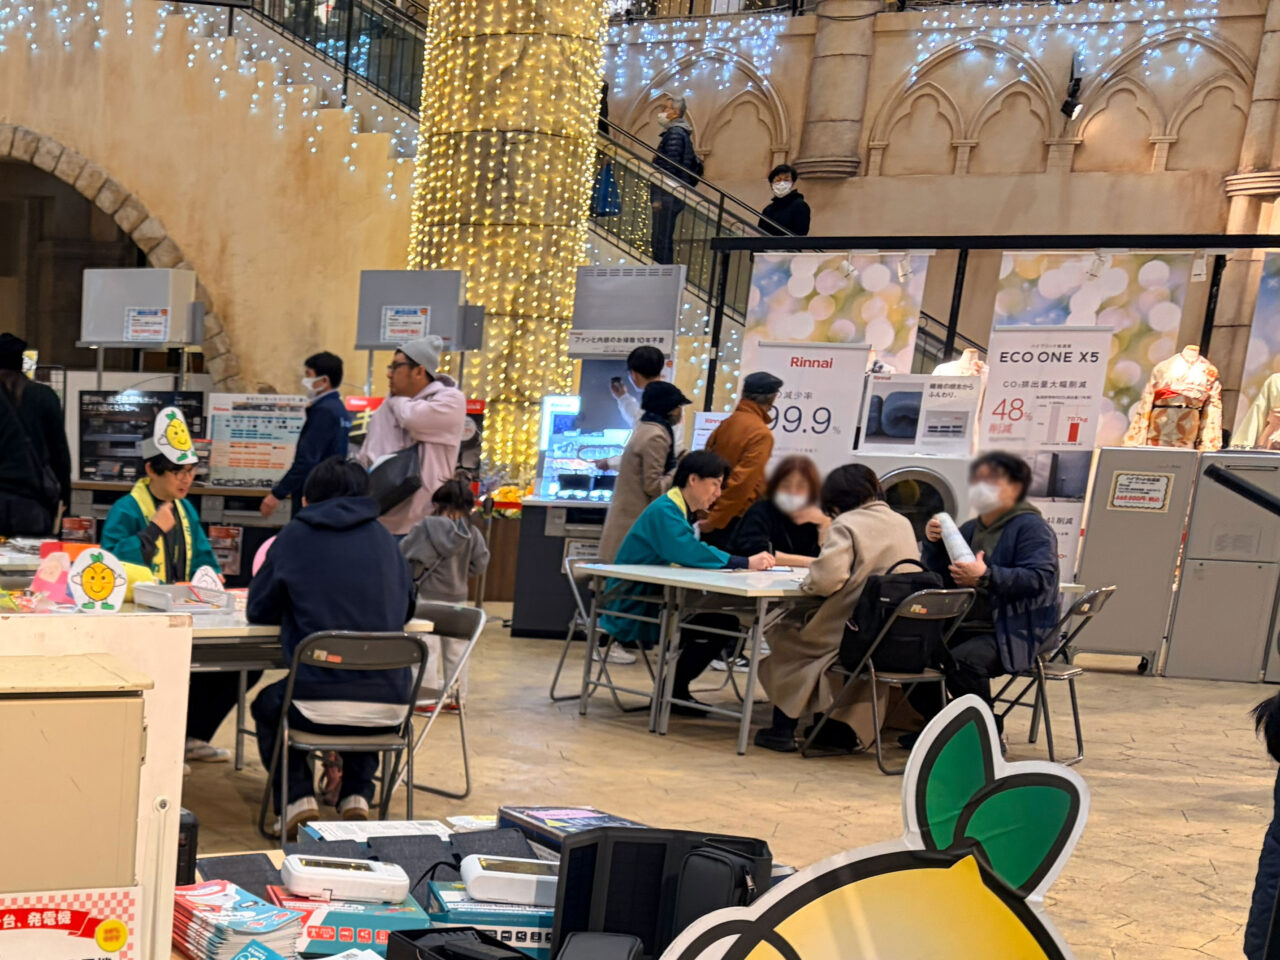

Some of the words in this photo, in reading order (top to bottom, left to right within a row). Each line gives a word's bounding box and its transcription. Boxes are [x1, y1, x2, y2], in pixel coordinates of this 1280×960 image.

[790, 357, 833, 369] Rinnai
[1000, 351, 1034, 363] ECO
[1037, 351, 1073, 363] ONE
[1078, 351, 1100, 363] X5
